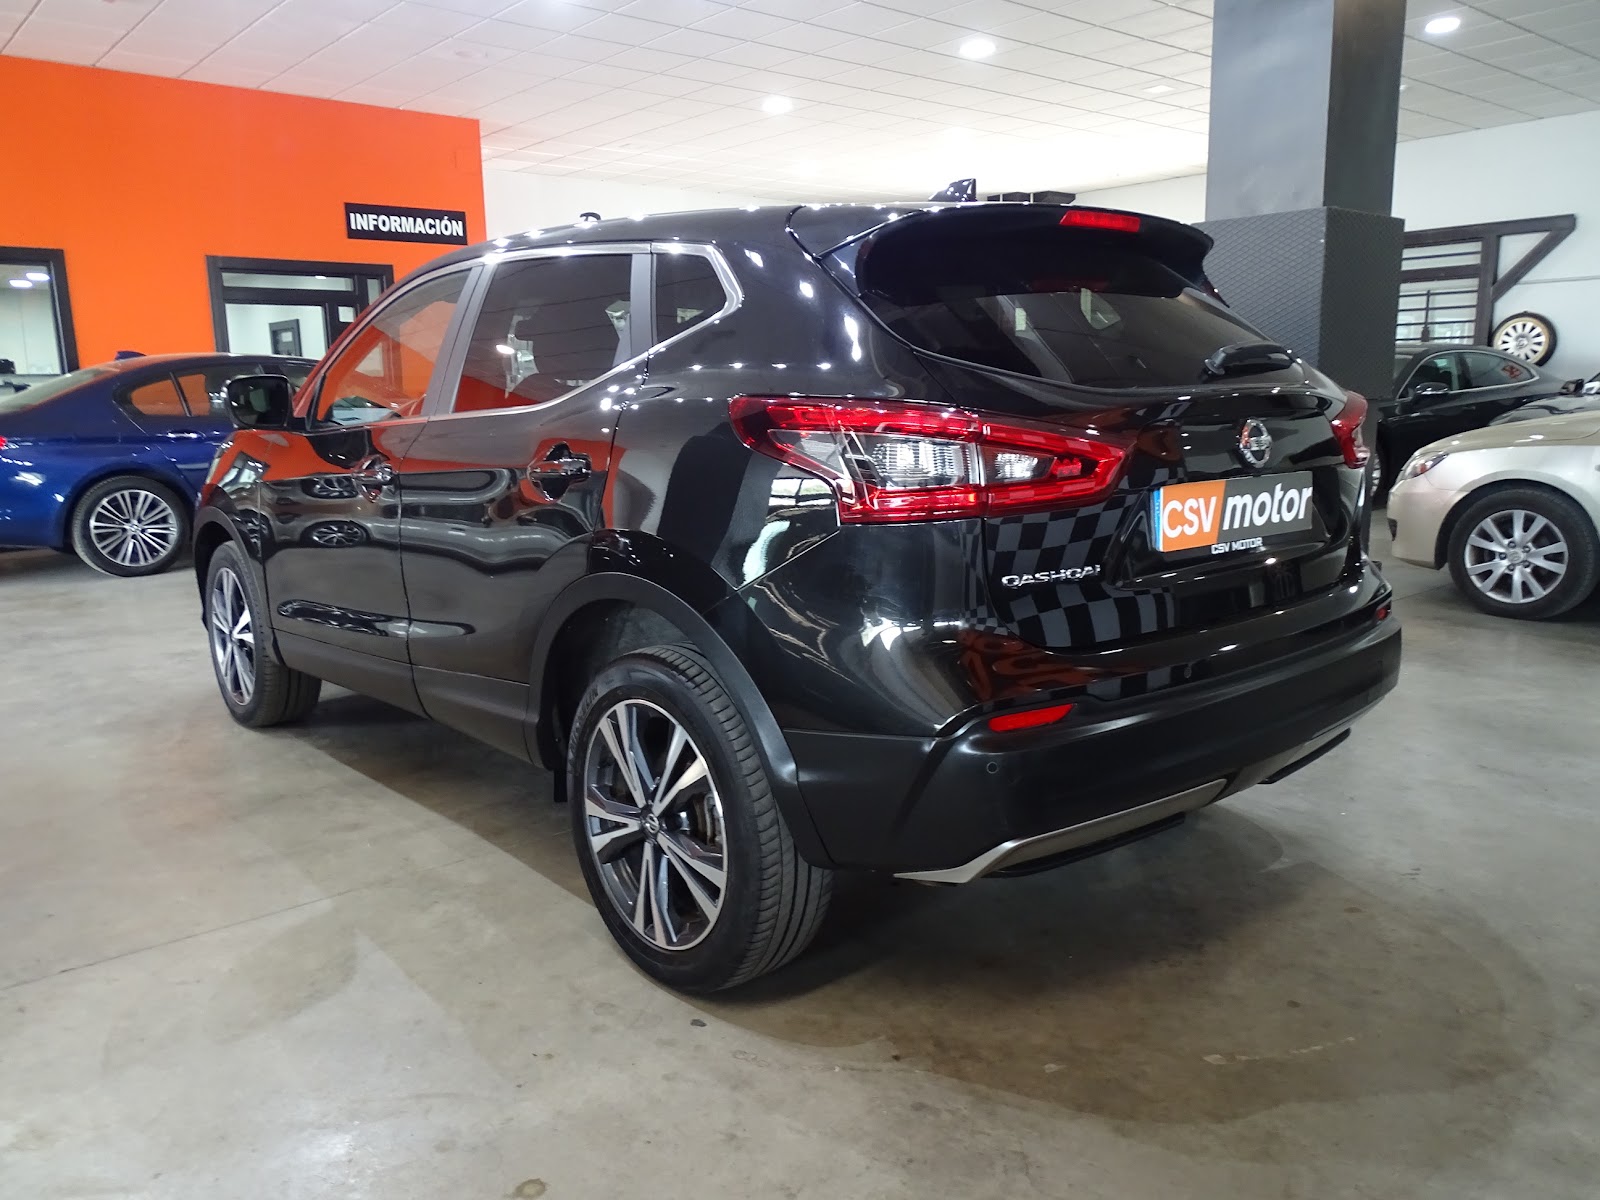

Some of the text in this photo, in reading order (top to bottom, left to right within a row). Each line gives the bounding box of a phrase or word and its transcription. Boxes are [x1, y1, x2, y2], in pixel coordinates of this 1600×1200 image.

[349, 212, 464, 237] INFORMACIÓN
[1163, 483, 1313, 538] CSV motor
[1211, 537, 1264, 555] CSV MOTOR
